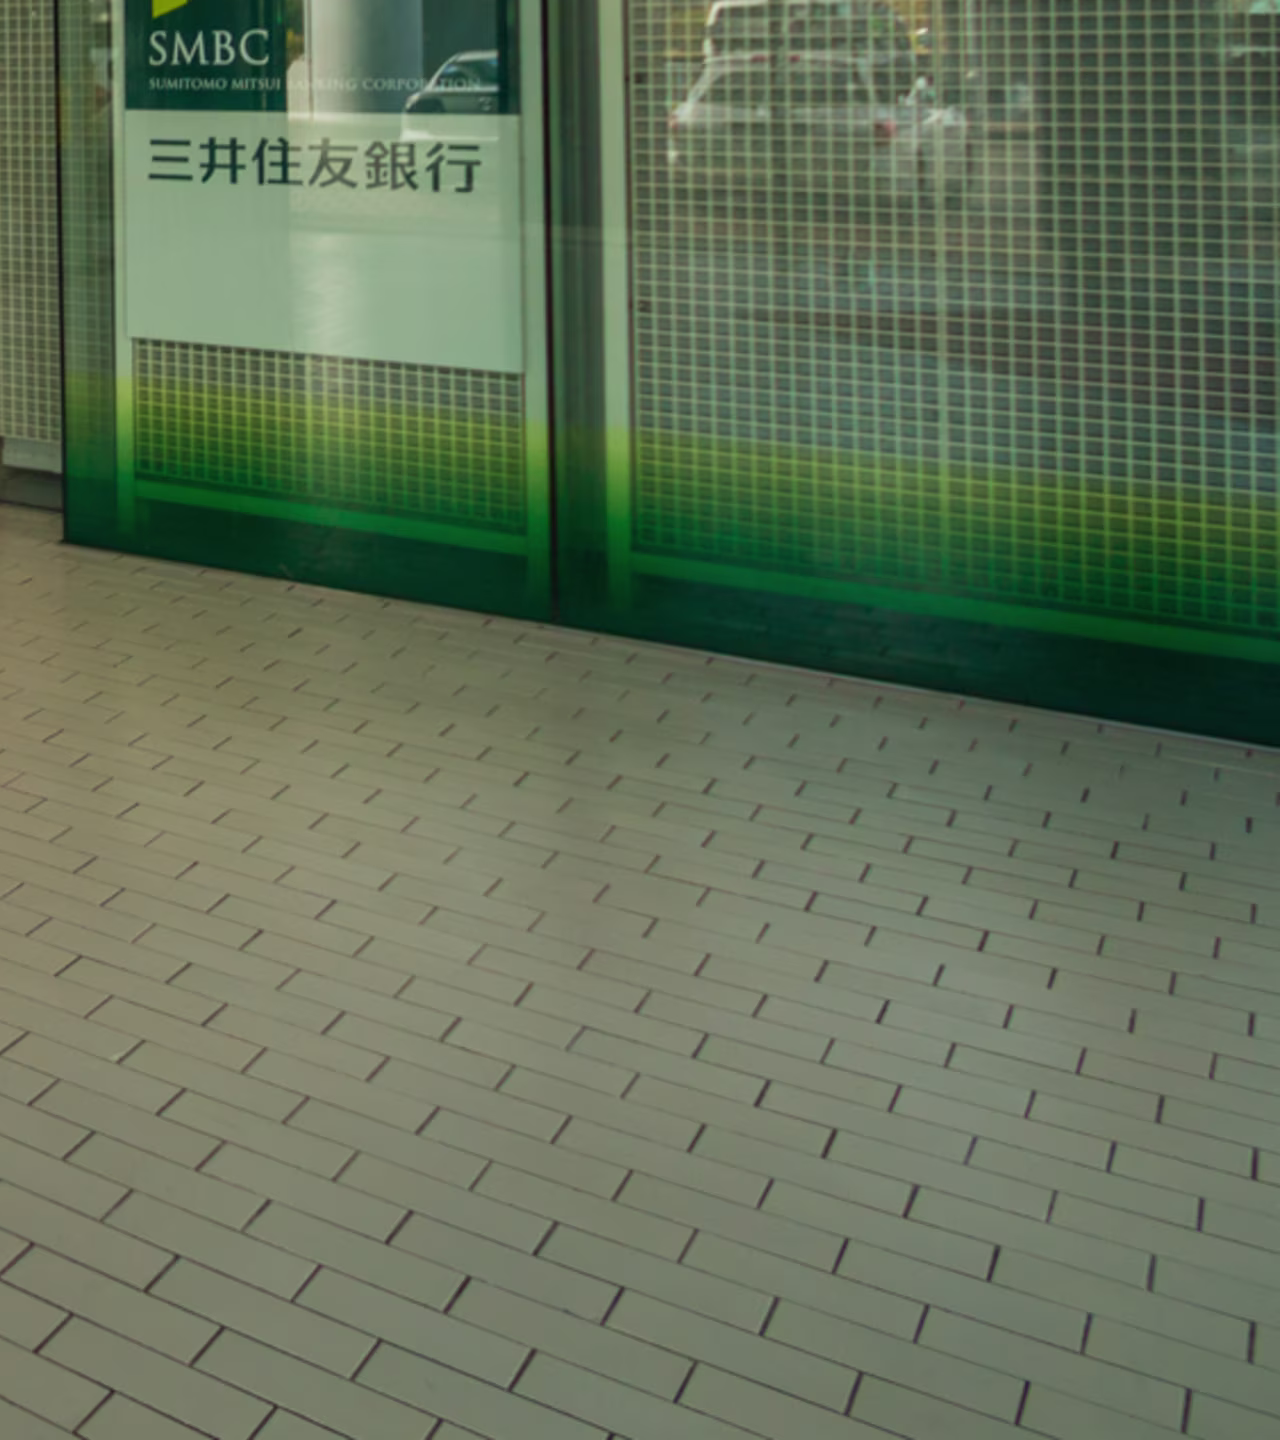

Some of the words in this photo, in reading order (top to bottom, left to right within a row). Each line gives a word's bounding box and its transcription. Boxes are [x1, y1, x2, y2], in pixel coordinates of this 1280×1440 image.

[148, 28, 270, 67] SMBC
[148, 77, 228, 91] SUMITOMO
[230, 77, 282, 91] MITSUI
[148, 136, 482, 193] 三井住友銀行
